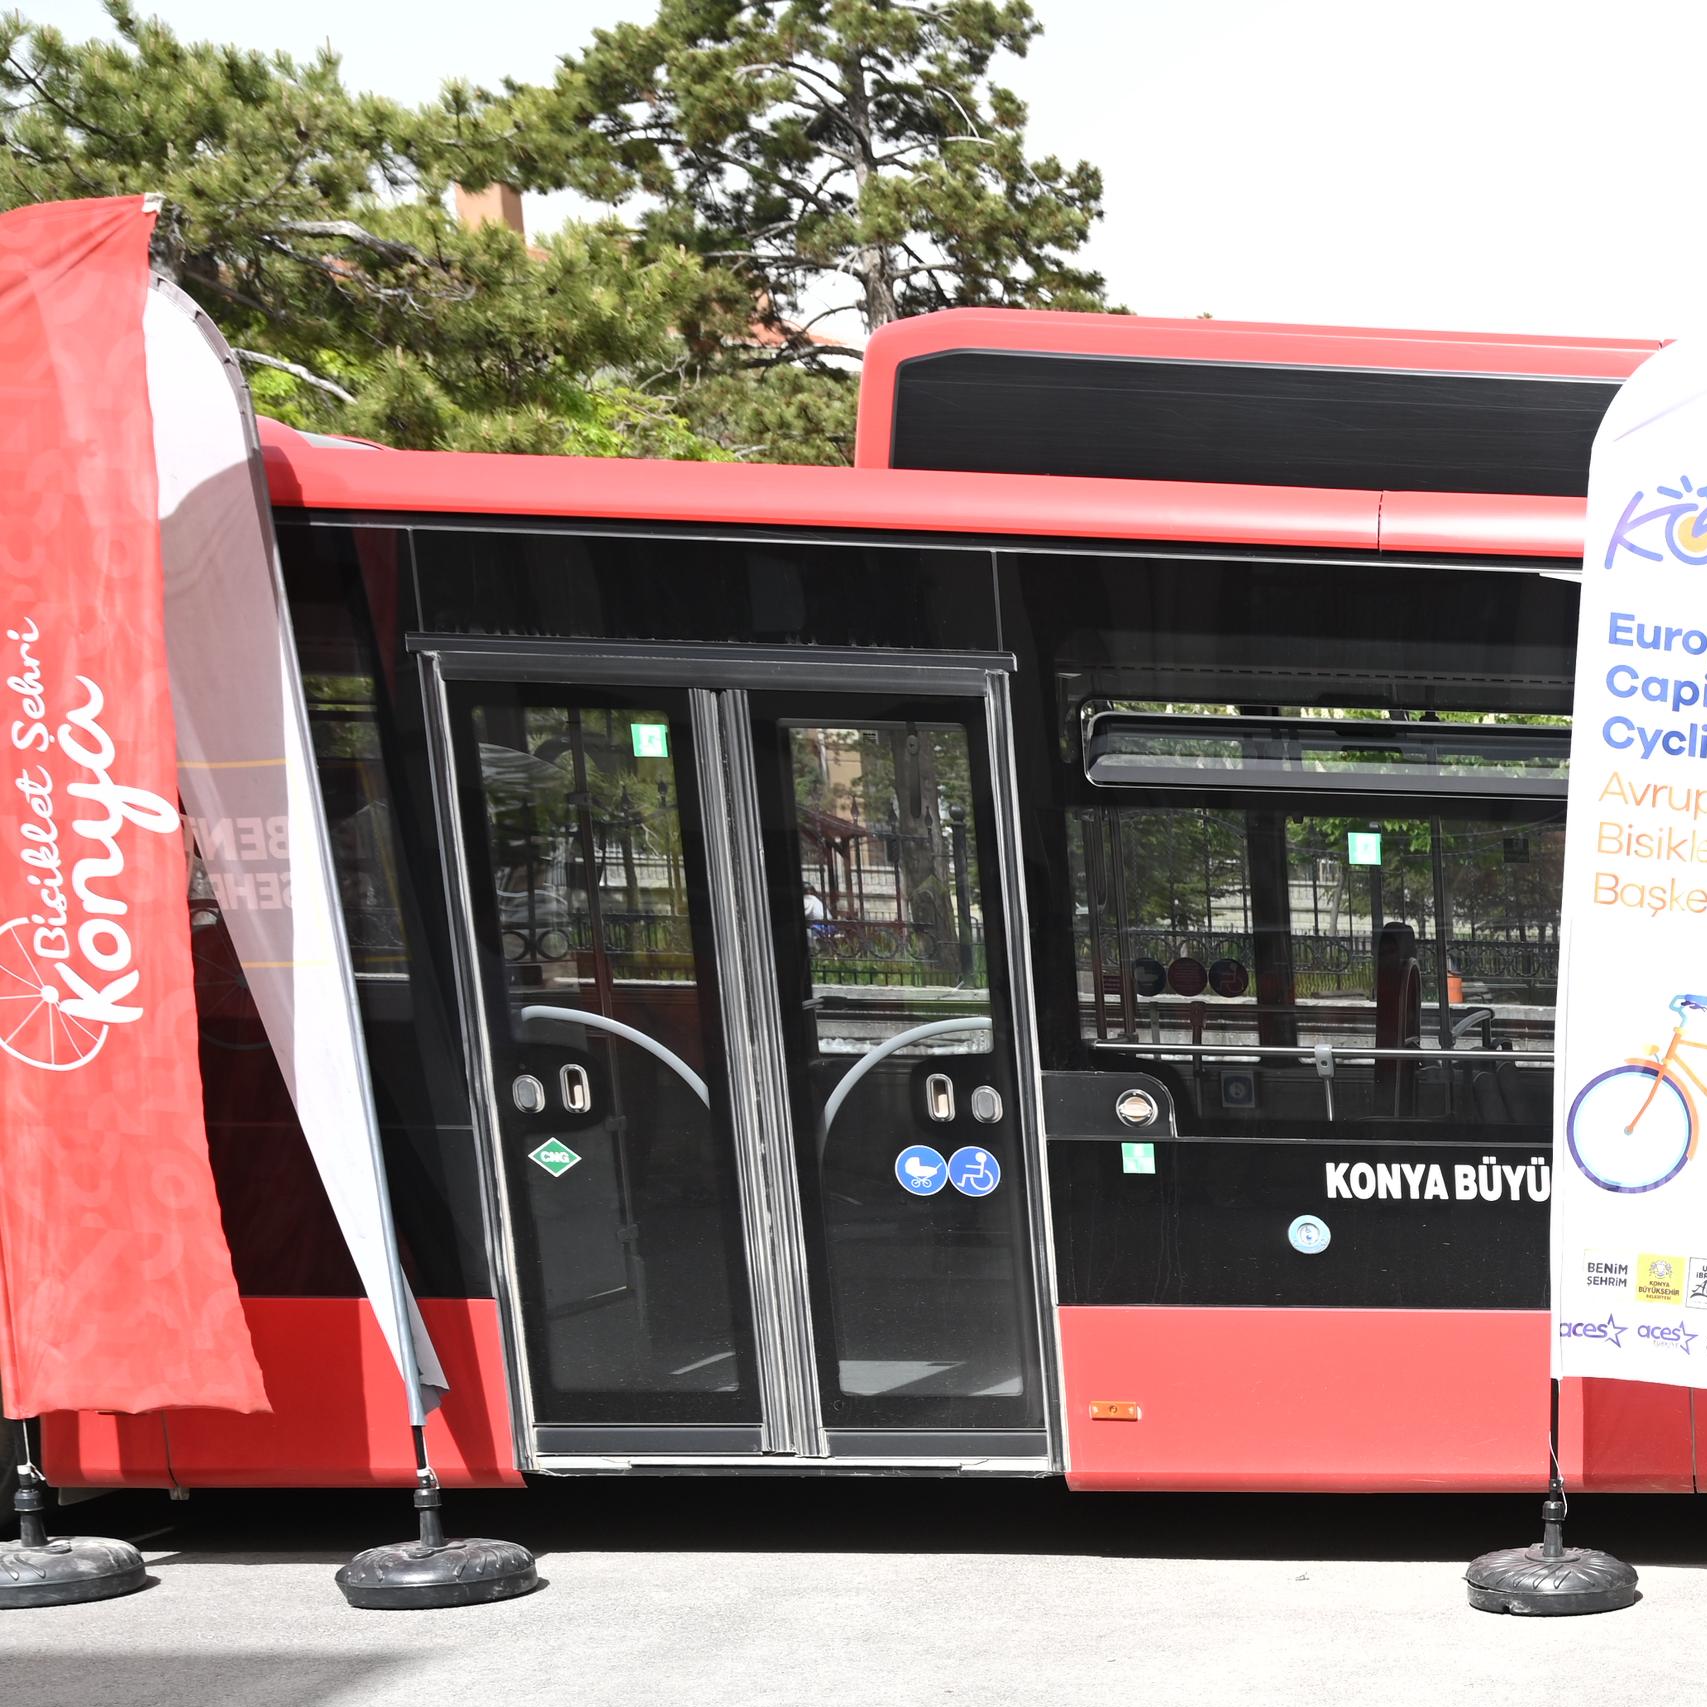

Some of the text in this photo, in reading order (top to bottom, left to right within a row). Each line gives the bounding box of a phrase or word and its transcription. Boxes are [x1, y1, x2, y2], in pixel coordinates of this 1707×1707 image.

[15, 765, 70, 959] Bisiklet
[54, 674, 181, 1024] Konya
[1325, 1162, 1448, 1200] KONYA
[1454, 1156, 1551, 1201] BÜYÜ
[1560, 1321, 1608, 1339] aces
[1637, 1324, 1682, 1341] aces
